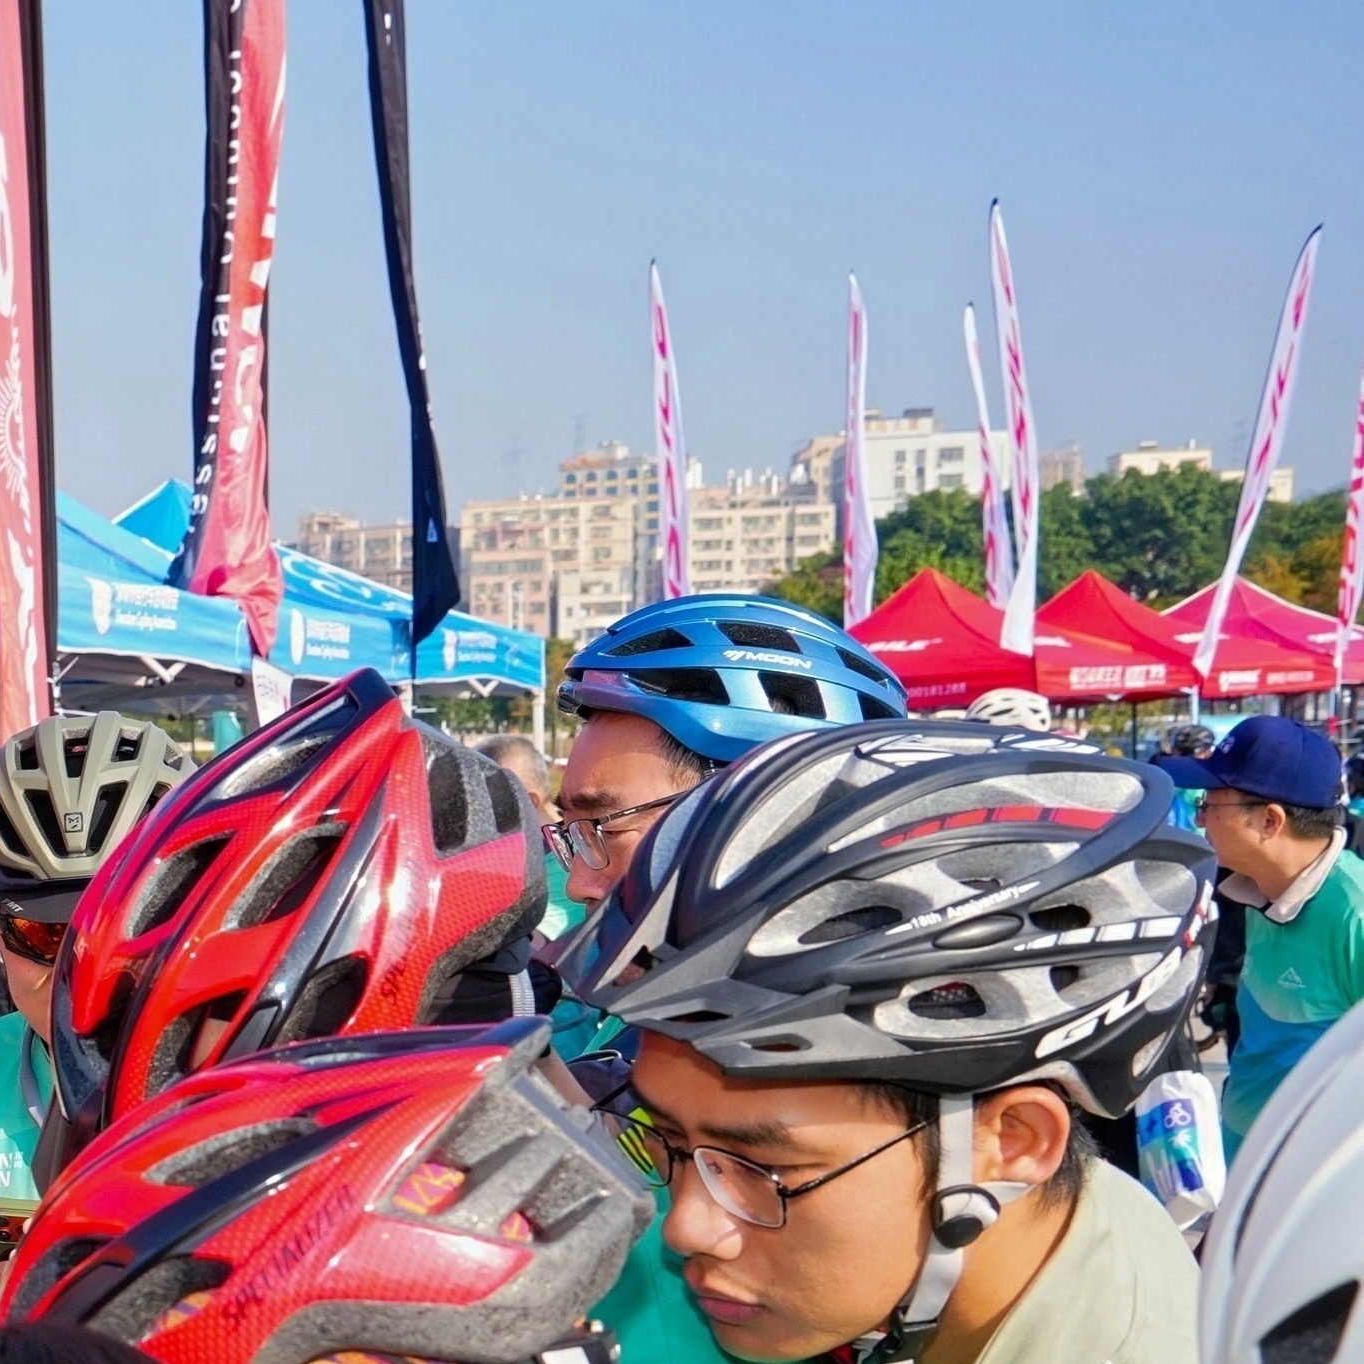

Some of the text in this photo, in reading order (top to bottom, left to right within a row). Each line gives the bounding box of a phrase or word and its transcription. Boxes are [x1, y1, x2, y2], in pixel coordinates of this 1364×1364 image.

[745, 652, 812, 670] MOON
[911, 885, 1020, 930] 18th Anniversary
